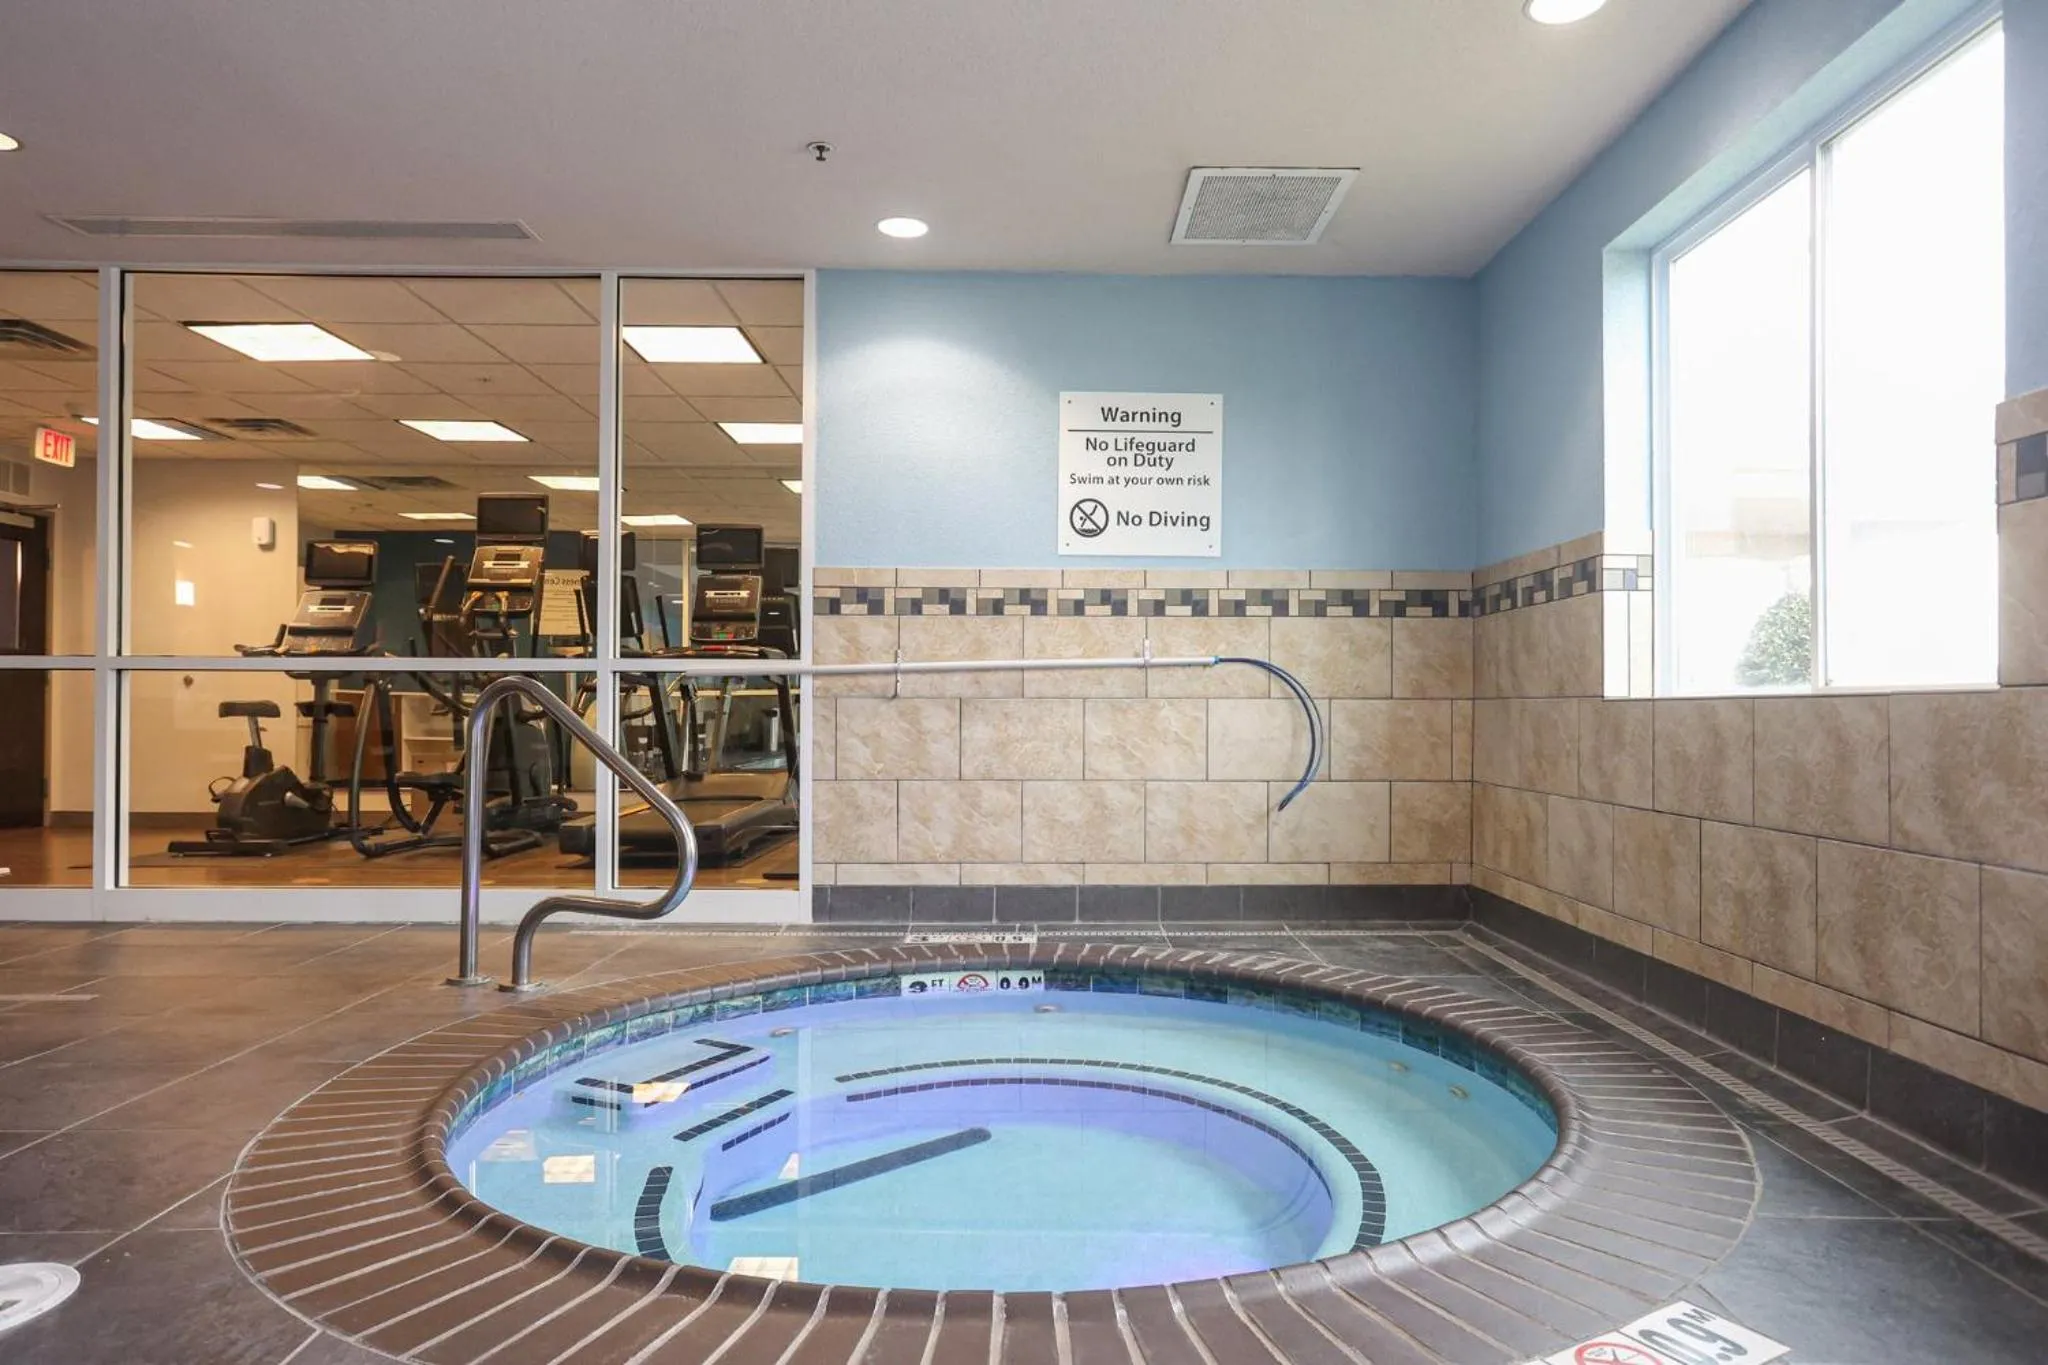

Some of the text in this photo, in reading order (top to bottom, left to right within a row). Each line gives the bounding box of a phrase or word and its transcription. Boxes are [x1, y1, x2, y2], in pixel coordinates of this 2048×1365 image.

[1100, 406, 1182, 428] Warning
[43, 430, 73, 463] EXIT
[1085, 437, 1196, 455] No Lifeguard
[1106, 453, 1175, 471] on Duty
[1069, 473, 1210, 488] Swim at your own risk
[1116, 511, 1211, 532] No Diving
